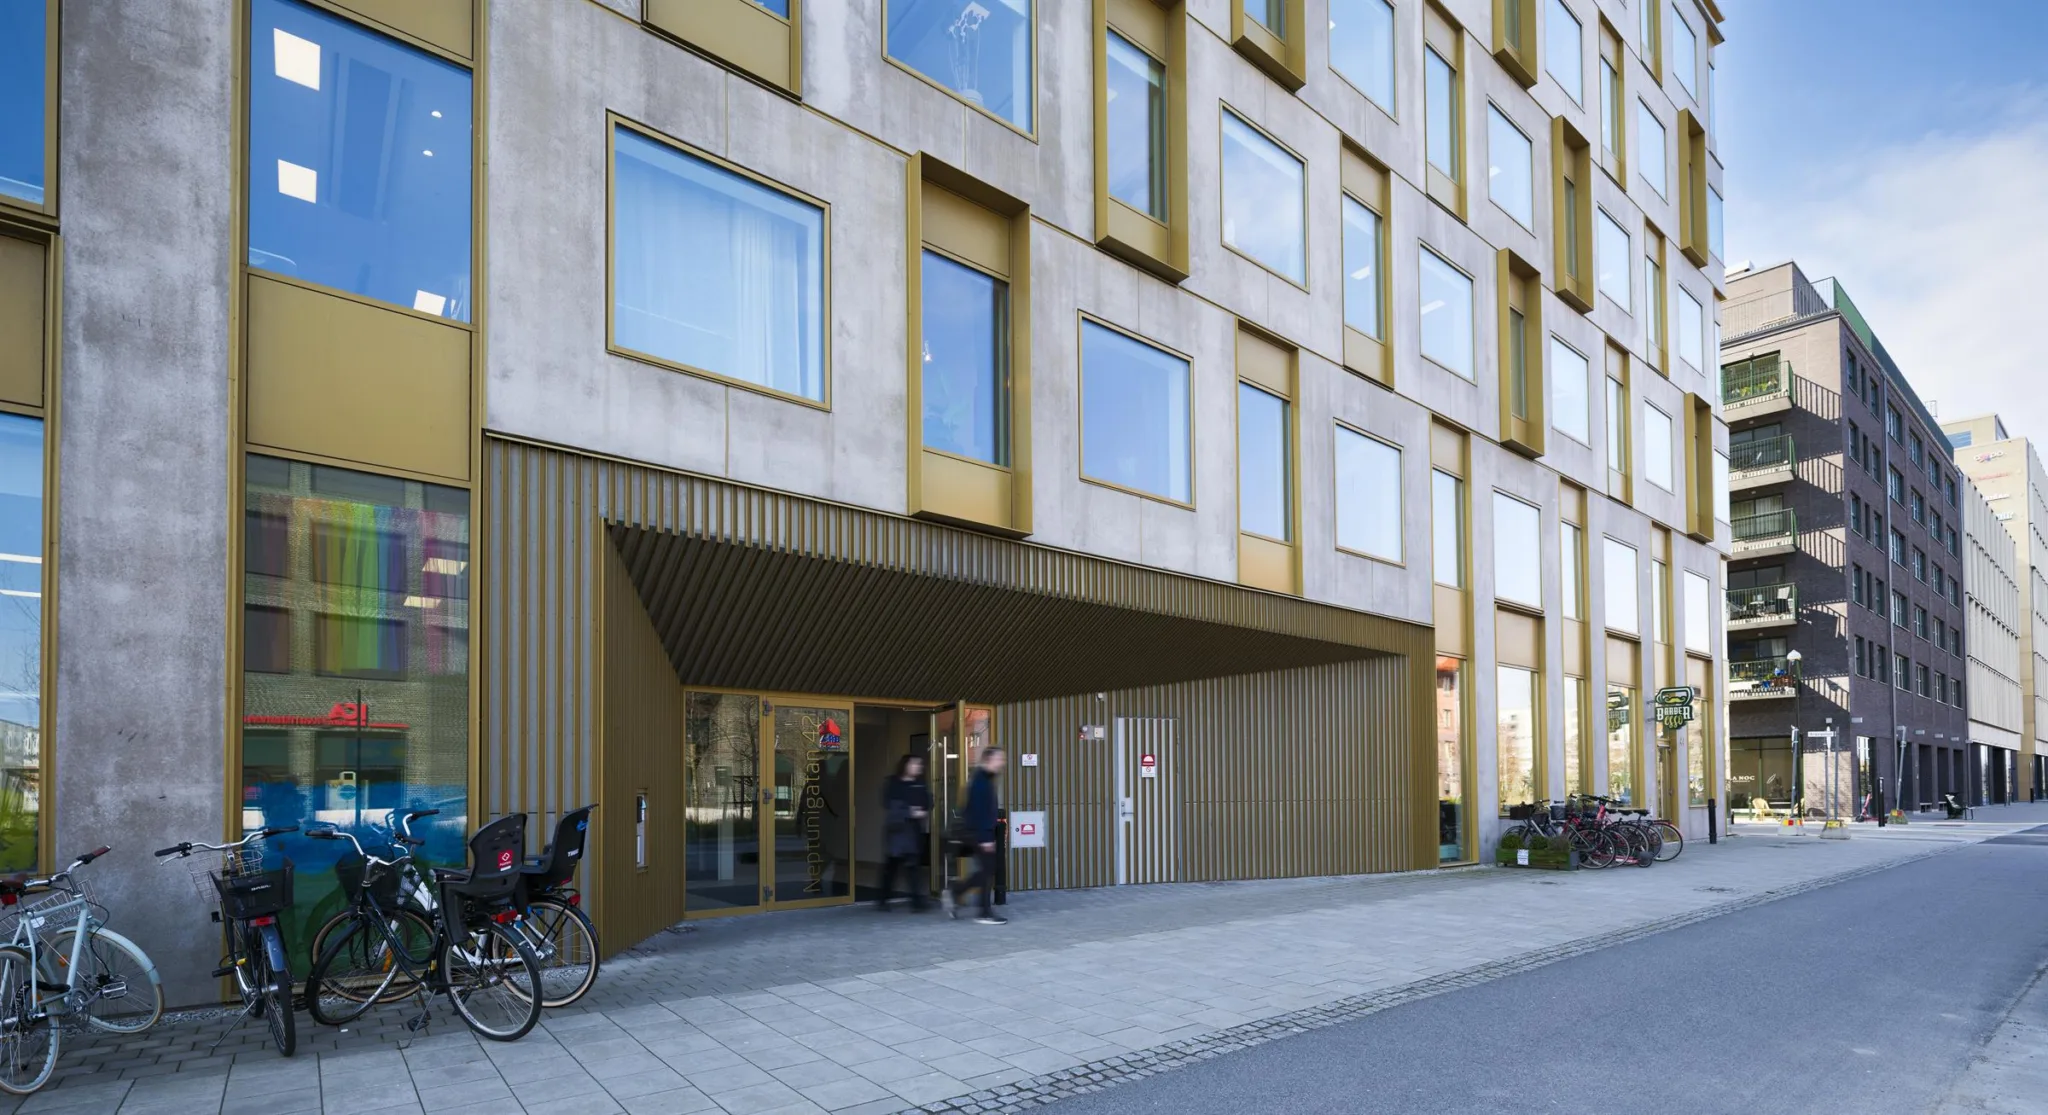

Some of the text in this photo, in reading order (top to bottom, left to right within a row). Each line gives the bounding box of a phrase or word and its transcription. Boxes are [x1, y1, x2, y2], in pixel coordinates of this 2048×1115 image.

[1656, 706, 1691, 721] BARBER
[801, 715, 825, 893] Neptunigatan 42
